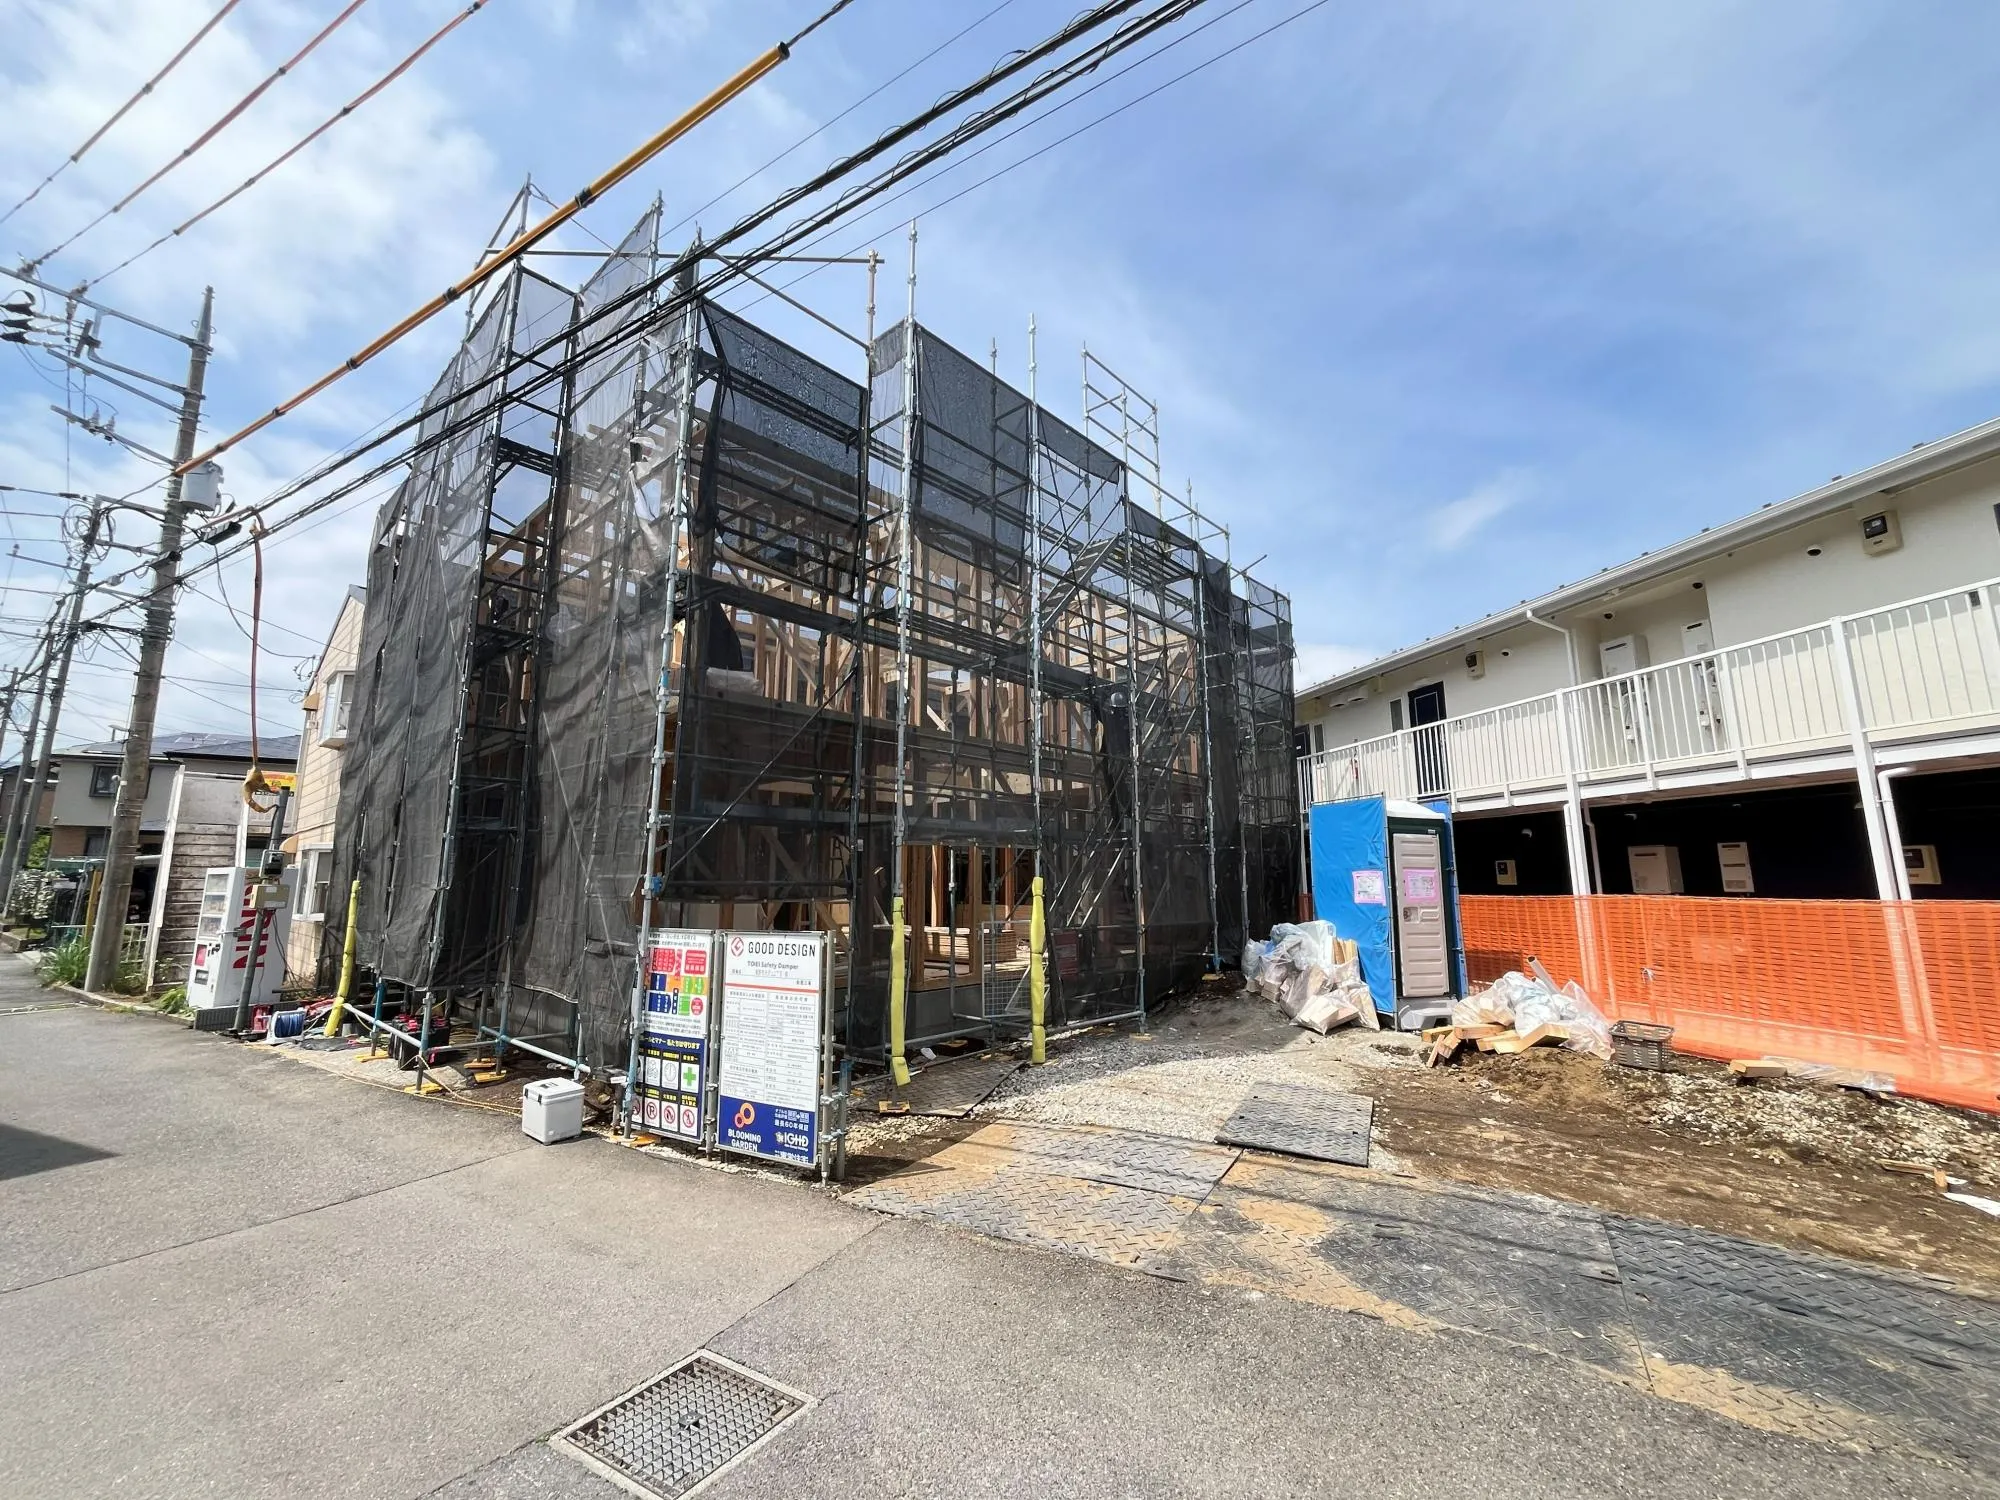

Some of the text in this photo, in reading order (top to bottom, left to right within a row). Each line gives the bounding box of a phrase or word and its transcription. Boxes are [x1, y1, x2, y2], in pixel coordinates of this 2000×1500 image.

[748, 941, 816, 957] GOOD DESIGN
[761, 961, 777, 969] Safety
[778, 962, 799, 970] Damper
[727, 1128, 762, 1143] BLOOMING
[731, 1139, 758, 1152] GARDEN
